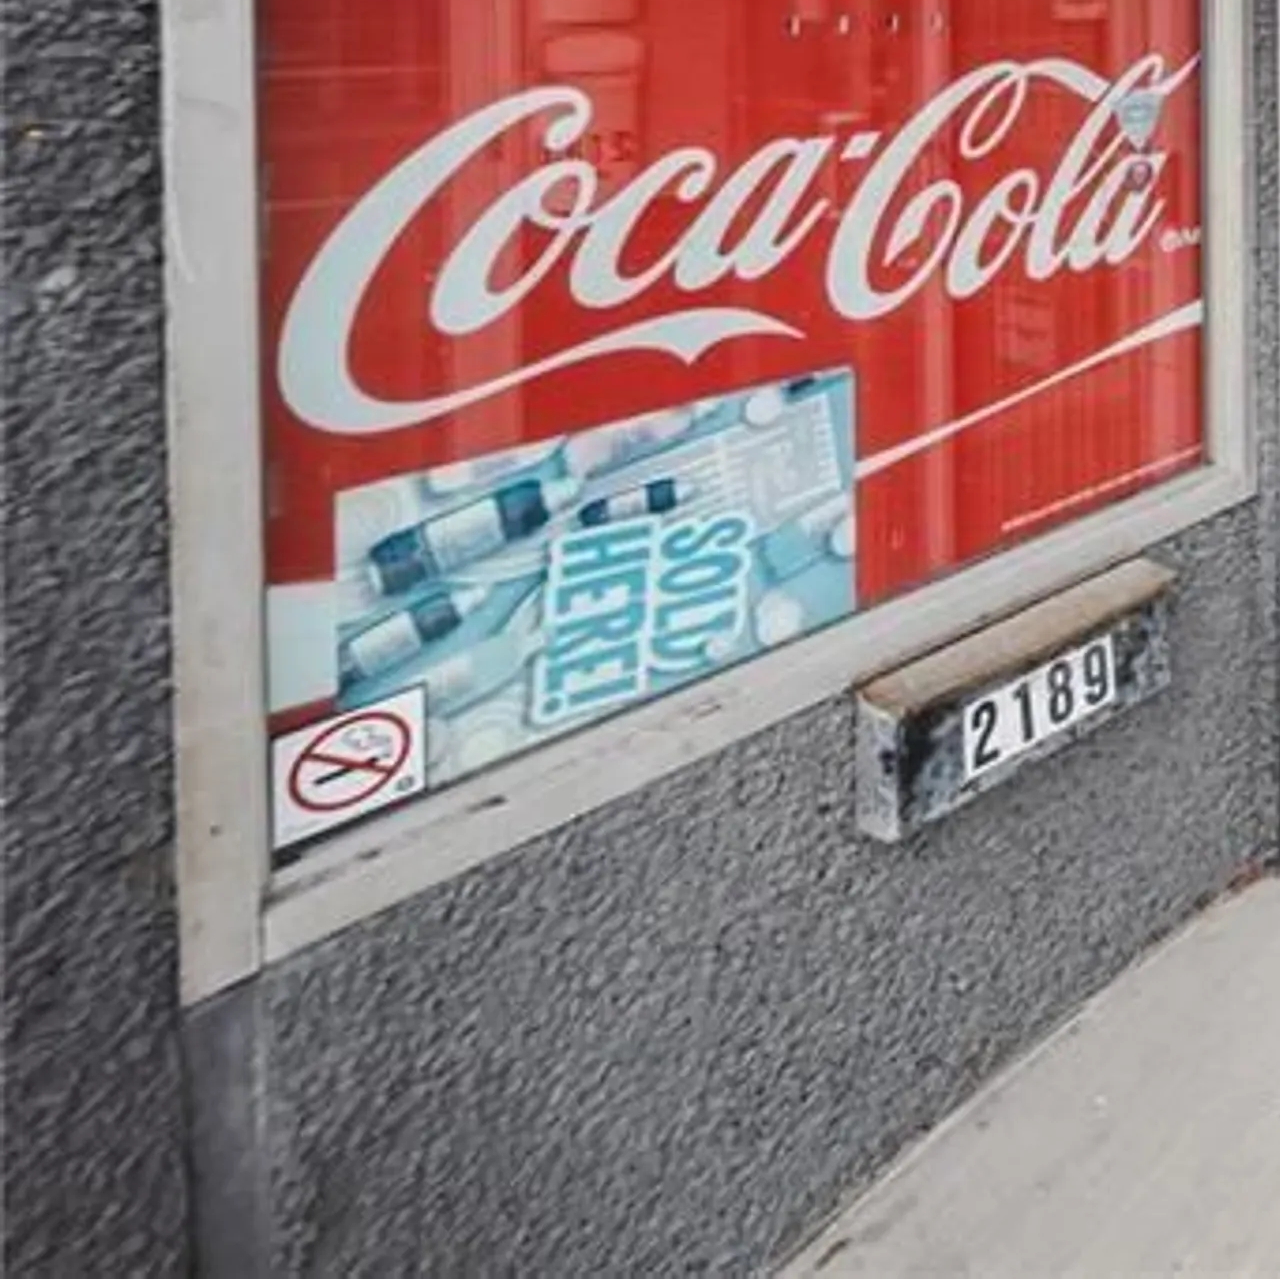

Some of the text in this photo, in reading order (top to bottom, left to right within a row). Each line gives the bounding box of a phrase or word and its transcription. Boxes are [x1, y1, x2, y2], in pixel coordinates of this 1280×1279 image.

[278, 53, 1202, 434] Coca-Cola
[542, 522, 652, 714] HERE!
[653, 517, 750, 661] SOLD
[970, 643, 1108, 769] 2189
